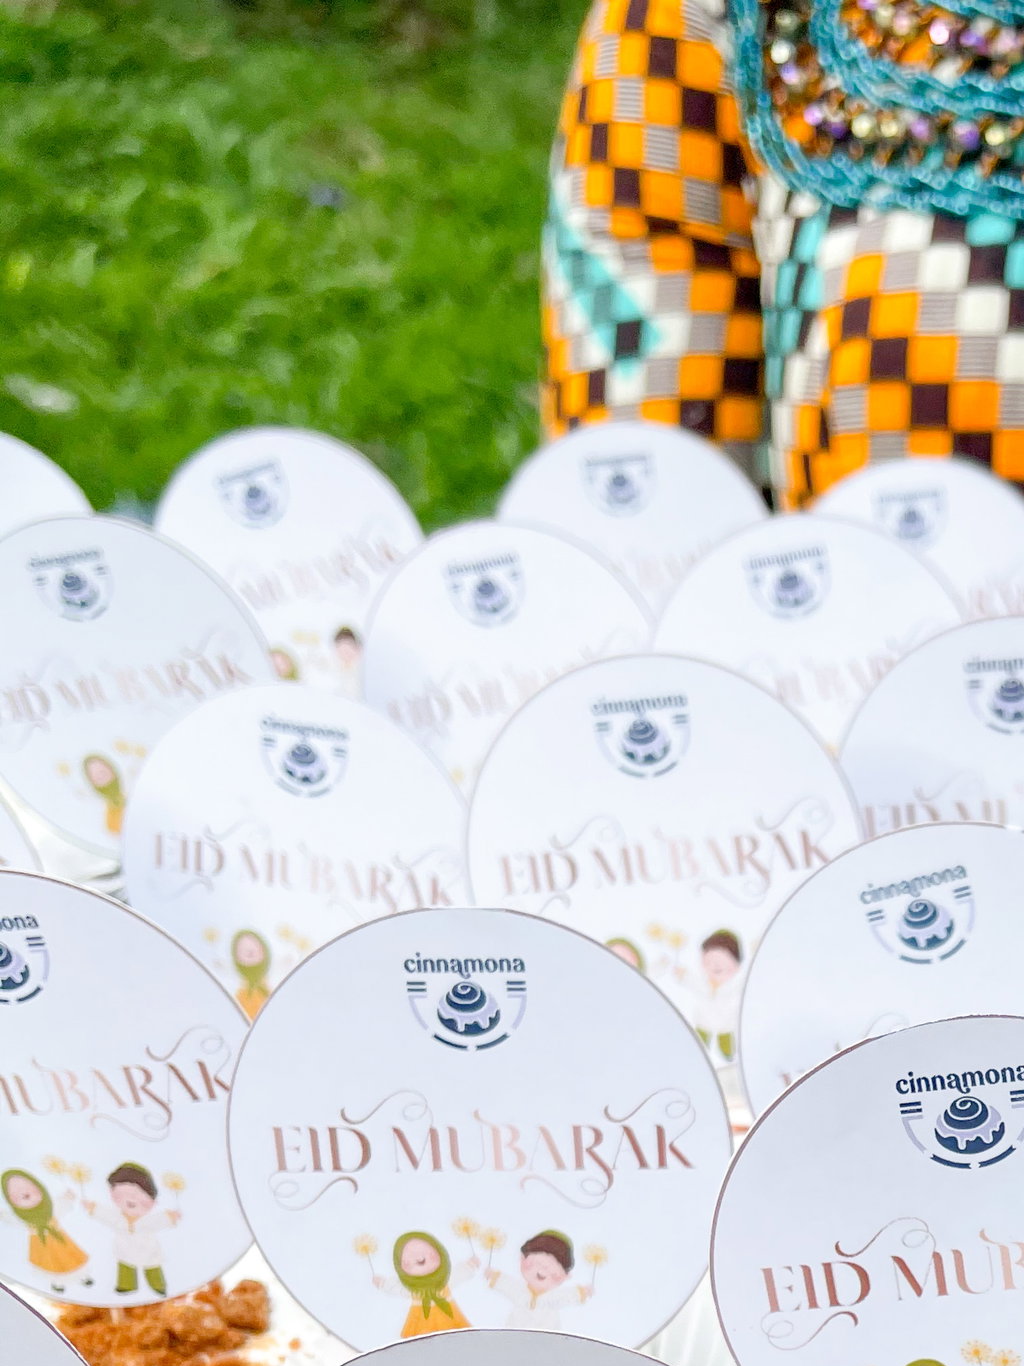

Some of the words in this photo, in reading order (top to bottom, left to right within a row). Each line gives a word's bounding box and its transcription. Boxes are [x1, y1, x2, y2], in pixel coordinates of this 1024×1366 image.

[500, 849, 578, 916] EID
[592, 799, 834, 906] MUBARAK
[859, 863, 968, 906] cinnamona
[402, 951, 526, 979] cinnamona
[269, 1122, 372, 1210] EID
[391, 1087, 697, 1208] MUBARAK
[760, 1258, 872, 1351] EID
